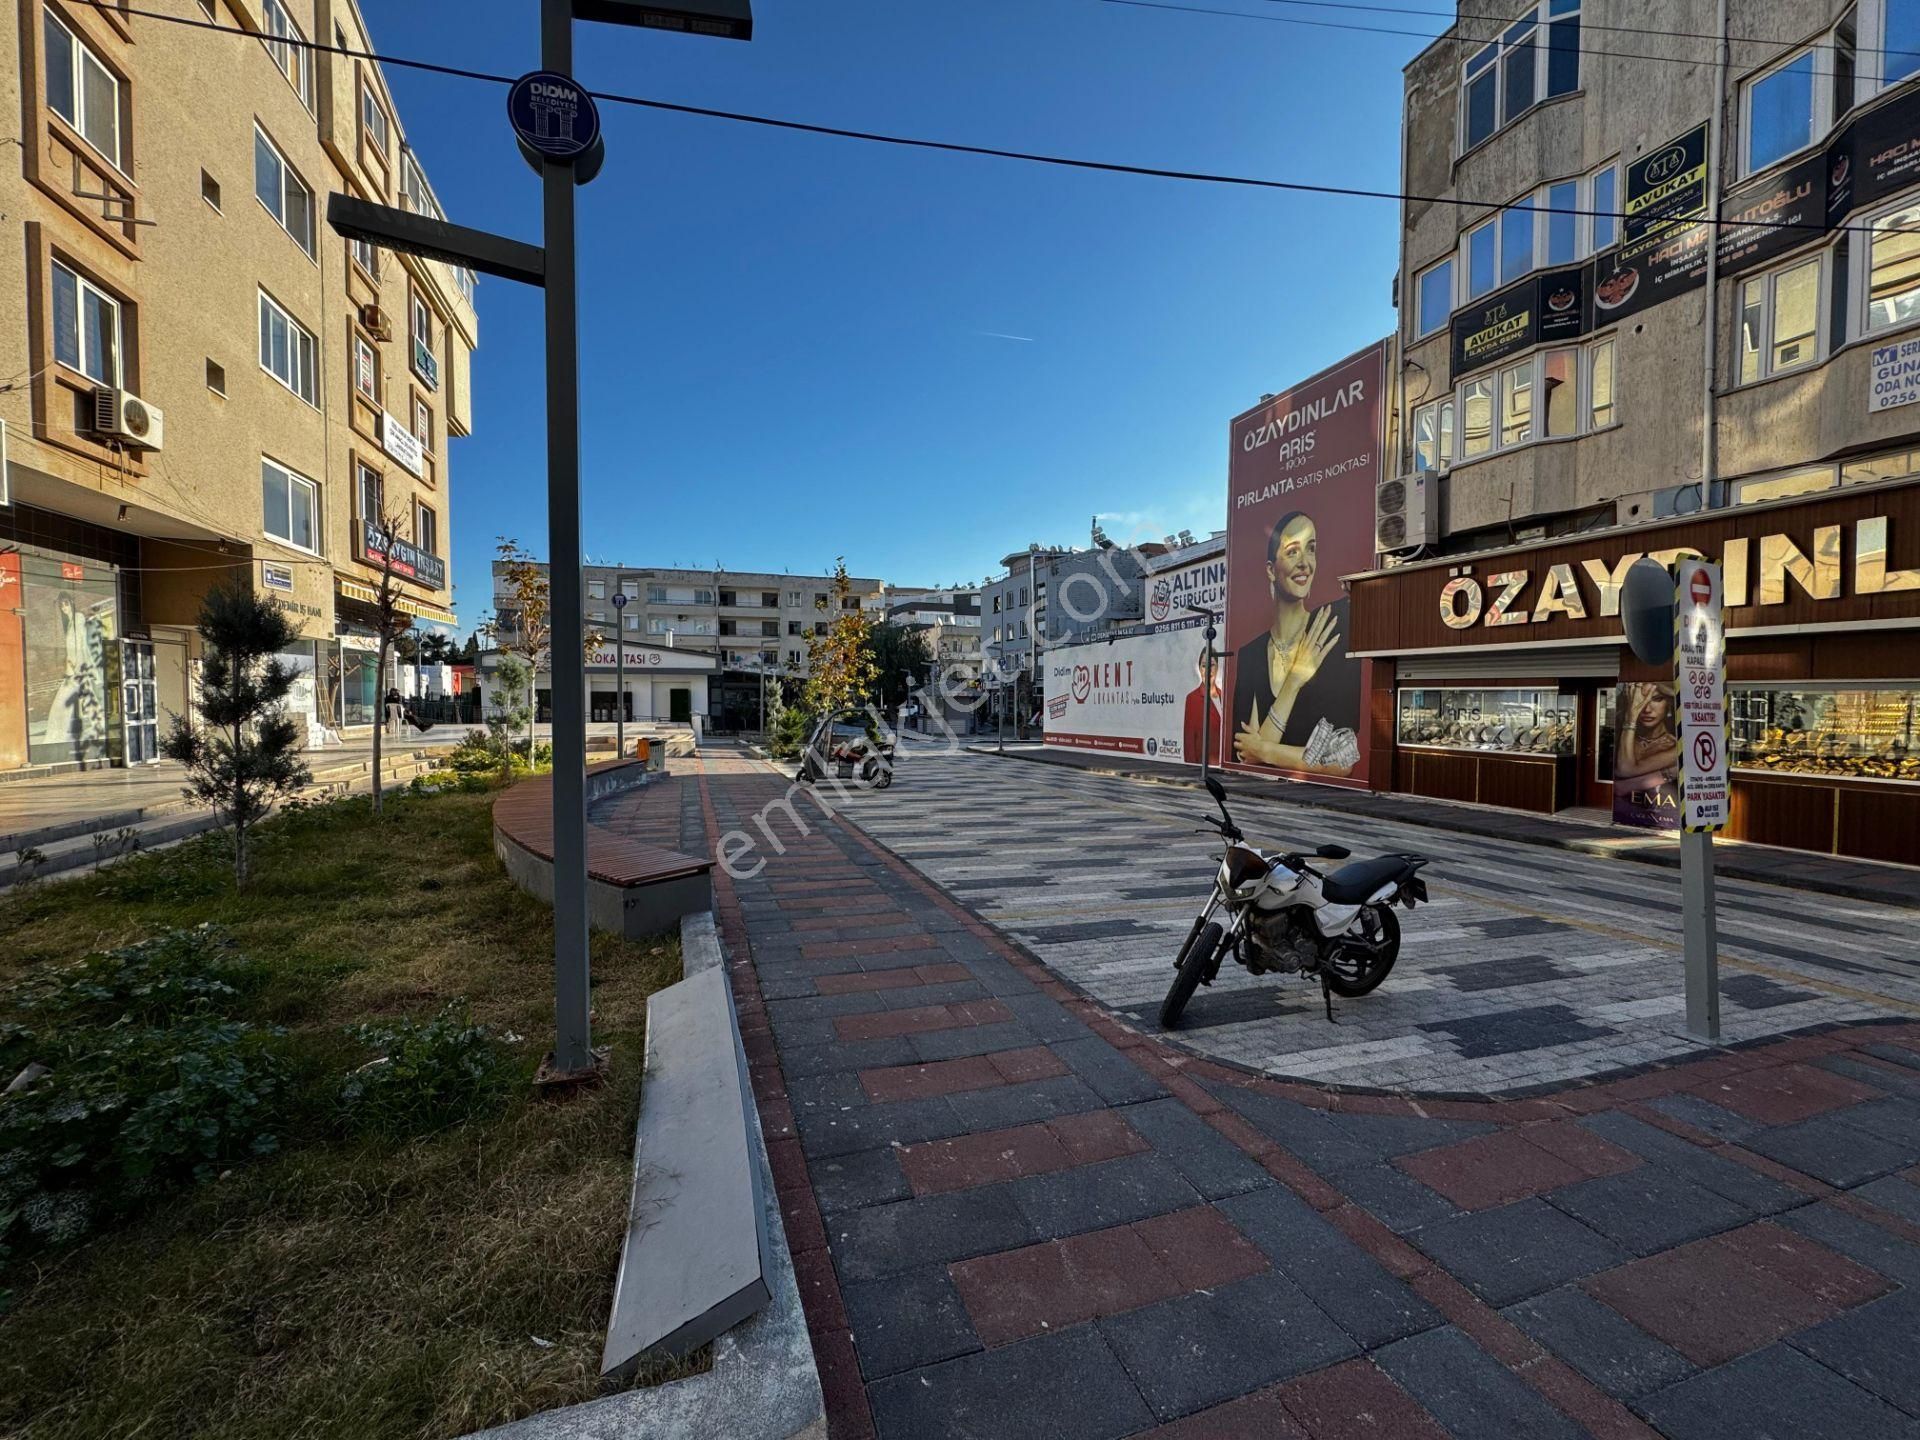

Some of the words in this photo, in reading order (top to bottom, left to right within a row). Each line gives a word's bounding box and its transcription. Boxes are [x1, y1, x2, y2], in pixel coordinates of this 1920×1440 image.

[1631, 168, 1700, 212] AVUKAT
[1469, 315, 1523, 348] AVUKAT
[1874, 379, 1901, 395] ODA
[1880, 390, 1917, 407] 0256
[1243, 379, 1365, 453] ÖZAYDINLAR
[1237, 477, 1295, 509] PIRLANTA
[1296, 470, 1324, 489] SATIŞ
[1325, 452, 1371, 479] NOKTASI
[1172, 588, 1217, 610] SÜRÜCÜ
[1053, 667, 1072, 677] Didim
[1093, 660, 1133, 689] KENT
[1141, 692, 1175, 706] Buluştu
[1631, 789, 1677, 808] EMA
[1687, 792, 1702, 801] PARK
[1702, 790, 1726, 800] YASAKTIR
